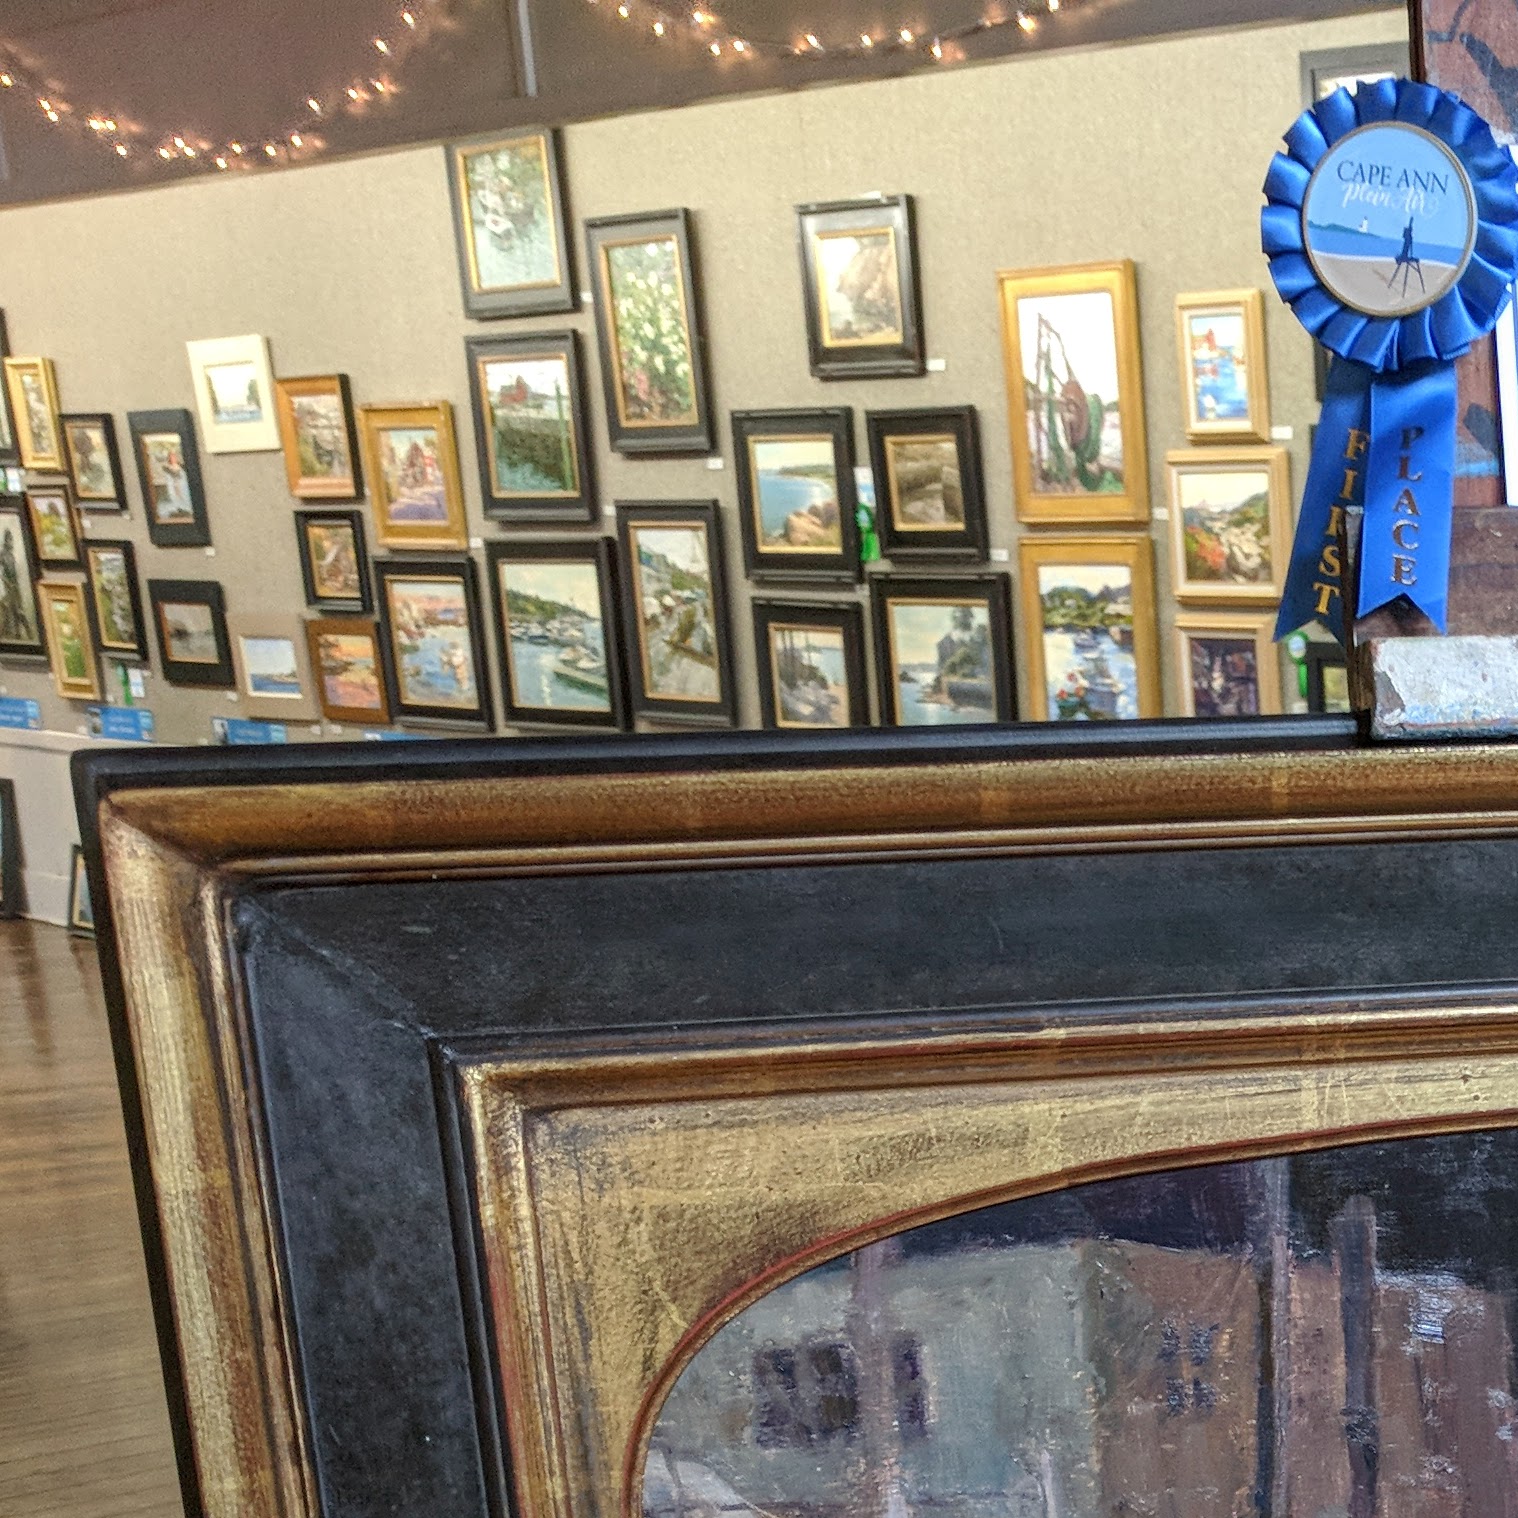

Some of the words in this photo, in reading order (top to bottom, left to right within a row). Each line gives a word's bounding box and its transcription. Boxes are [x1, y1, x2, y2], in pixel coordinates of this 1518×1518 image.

[1337, 160, 1392, 187] CAPE
[1397, 168, 1449, 195] ANN
[1390, 426, 1425, 586] PLACE
